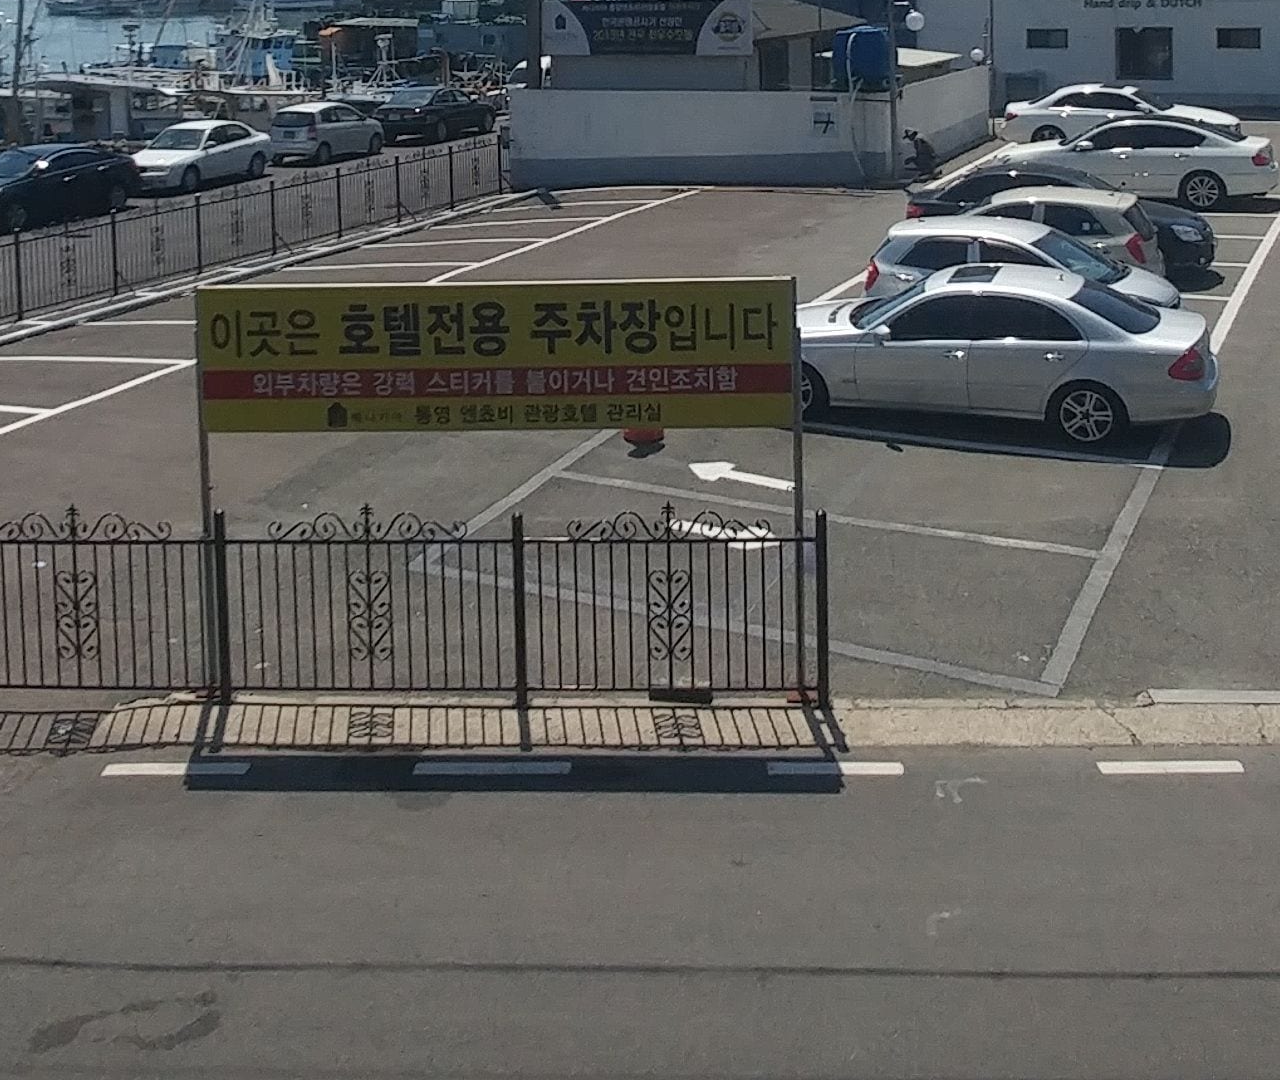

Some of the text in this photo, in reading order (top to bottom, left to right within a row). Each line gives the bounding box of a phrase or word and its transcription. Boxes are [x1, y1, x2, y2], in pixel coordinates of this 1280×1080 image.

[1083, 0, 1114, 8] Hand
[210, 299, 779, 358] 이곳은 호텔전용 주차장입니다
[252, 365, 739, 398] 외부차량은 강력 스티커를 붙이거나 견인조치함
[415, 403, 452, 426] 통영
[524, 401, 598, 424] 관광호텔
[606, 401, 663, 423] 관리실
